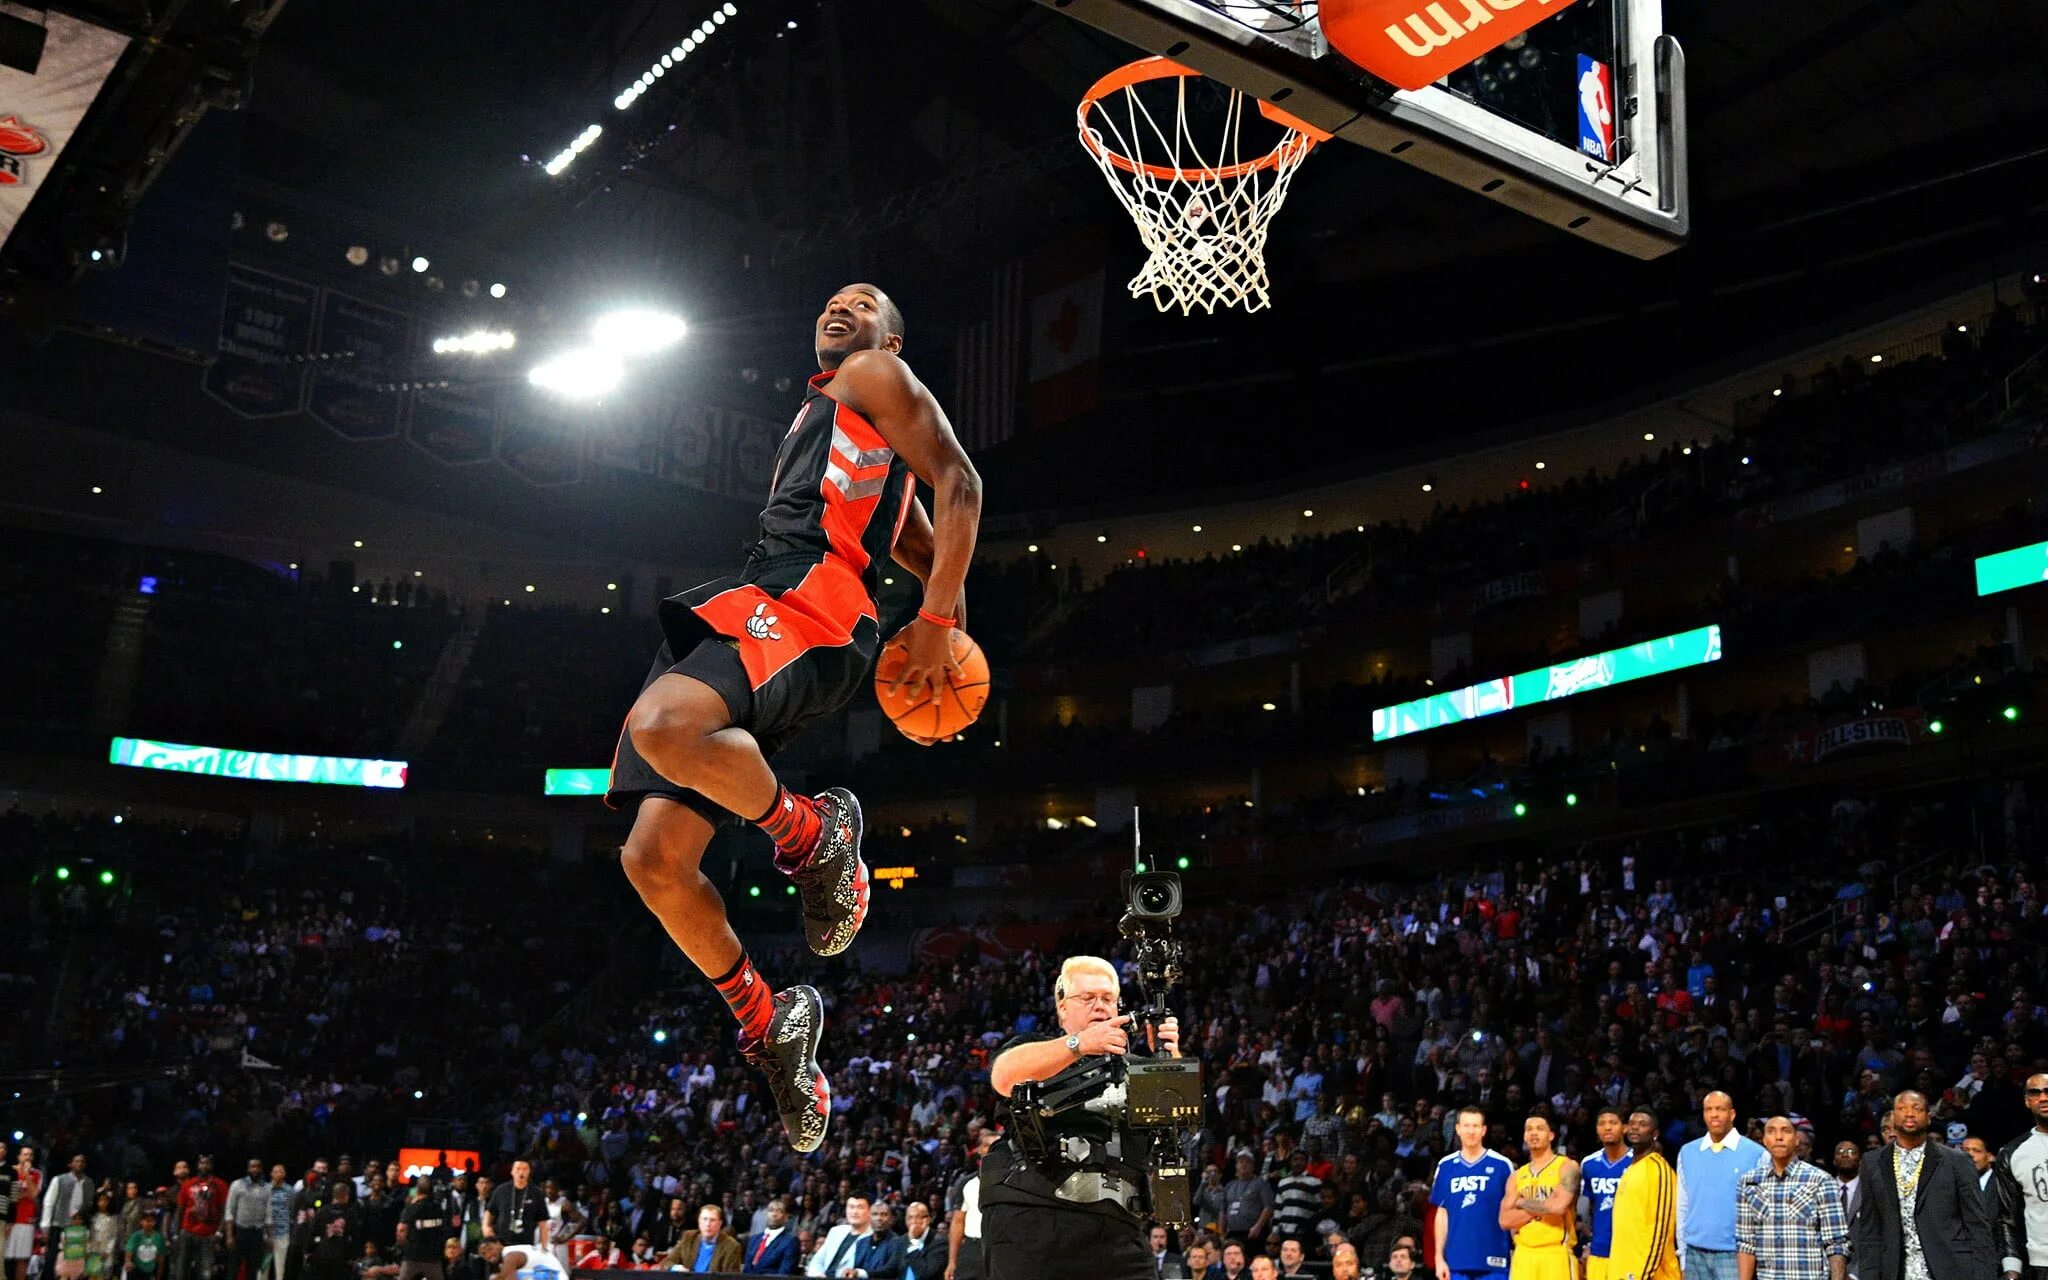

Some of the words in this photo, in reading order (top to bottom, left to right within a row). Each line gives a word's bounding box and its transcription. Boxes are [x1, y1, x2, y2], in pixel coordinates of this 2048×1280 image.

[1384, 0, 1527, 57] rm
[1583, 136, 1603, 158] NBA
[1450, 1175, 1489, 1194] EAST
